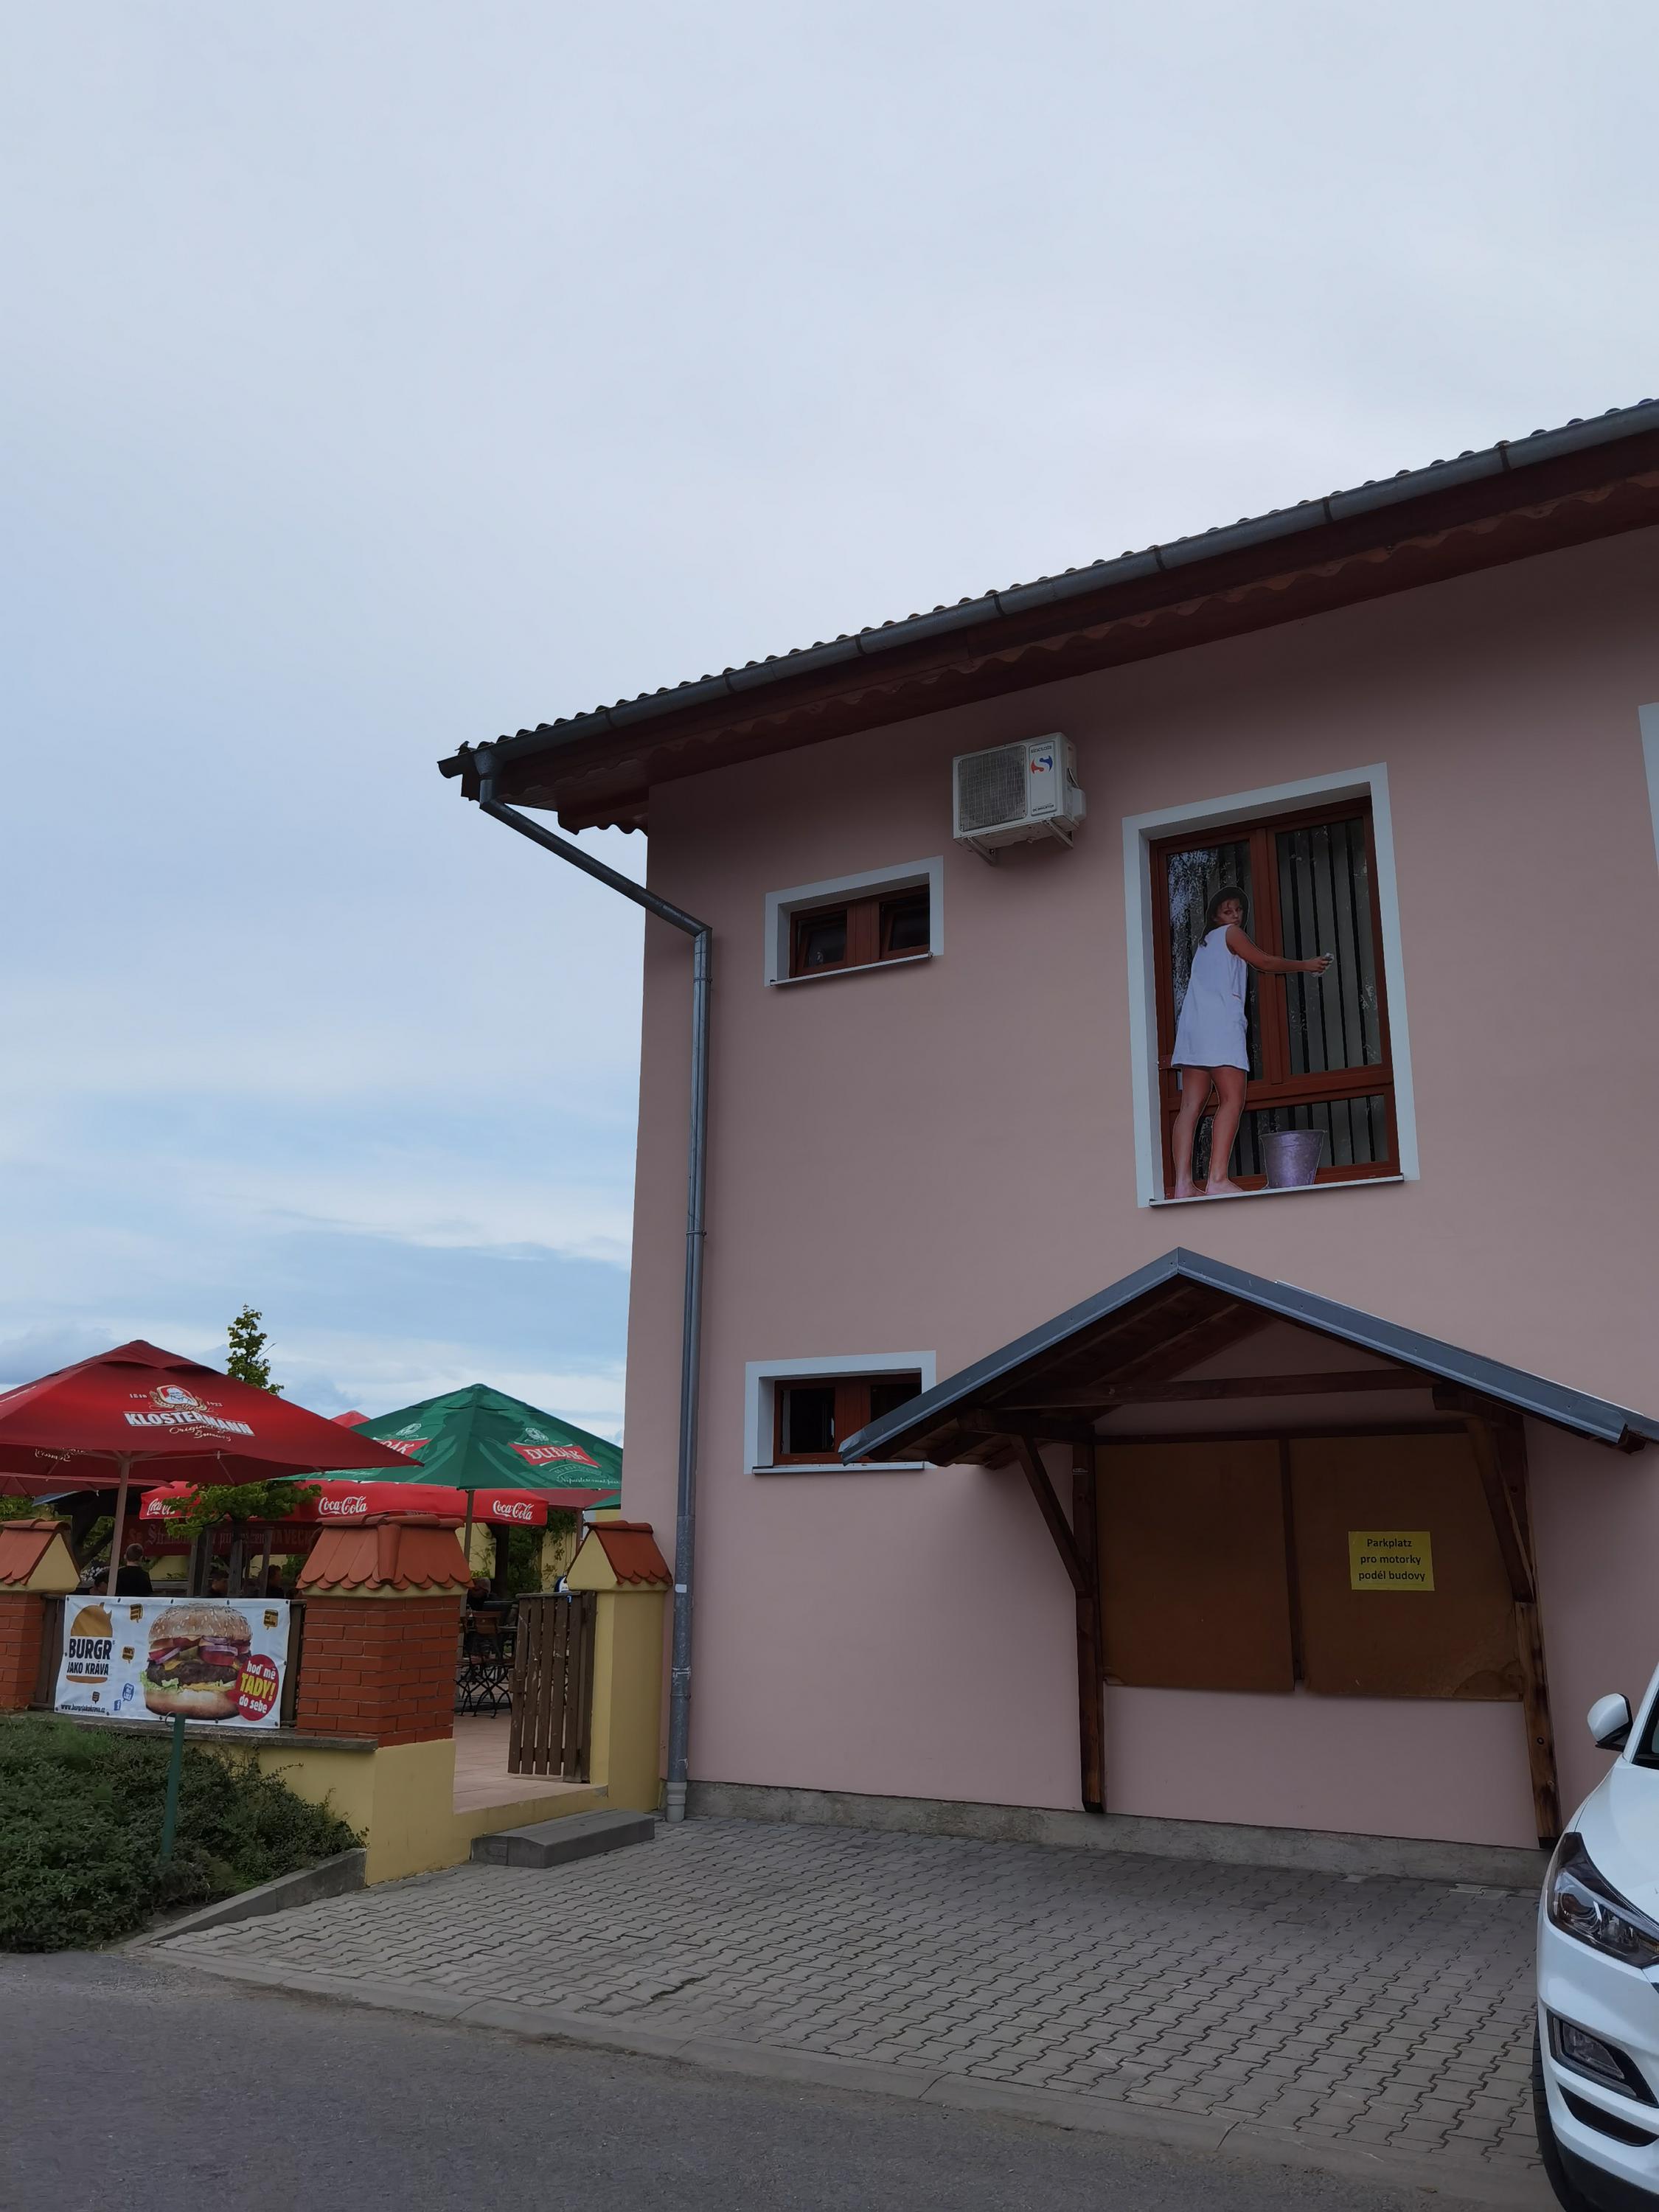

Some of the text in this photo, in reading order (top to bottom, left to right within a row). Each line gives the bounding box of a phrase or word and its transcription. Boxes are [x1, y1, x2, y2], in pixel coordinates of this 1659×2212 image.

[123, 1411, 254, 1436] KLOSTERMANN
[318, 1496, 367, 1515] Coca-Cola
[493, 1500, 535, 1520] Coca-Cola
[1367, 1538, 1412, 1548] Parkplatz
[1360, 1555, 1422, 1565] pro motorky
[1358, 1571, 1426, 1582] podél budovy
[69, 1638, 113, 1660] BURGR
[67, 1660, 109, 1676] JAKO KRÁVA
[263, 1668, 276, 1680] mě
[240, 1672, 276, 1701] TADY!
[239, 1694, 268, 1714] do sebe
